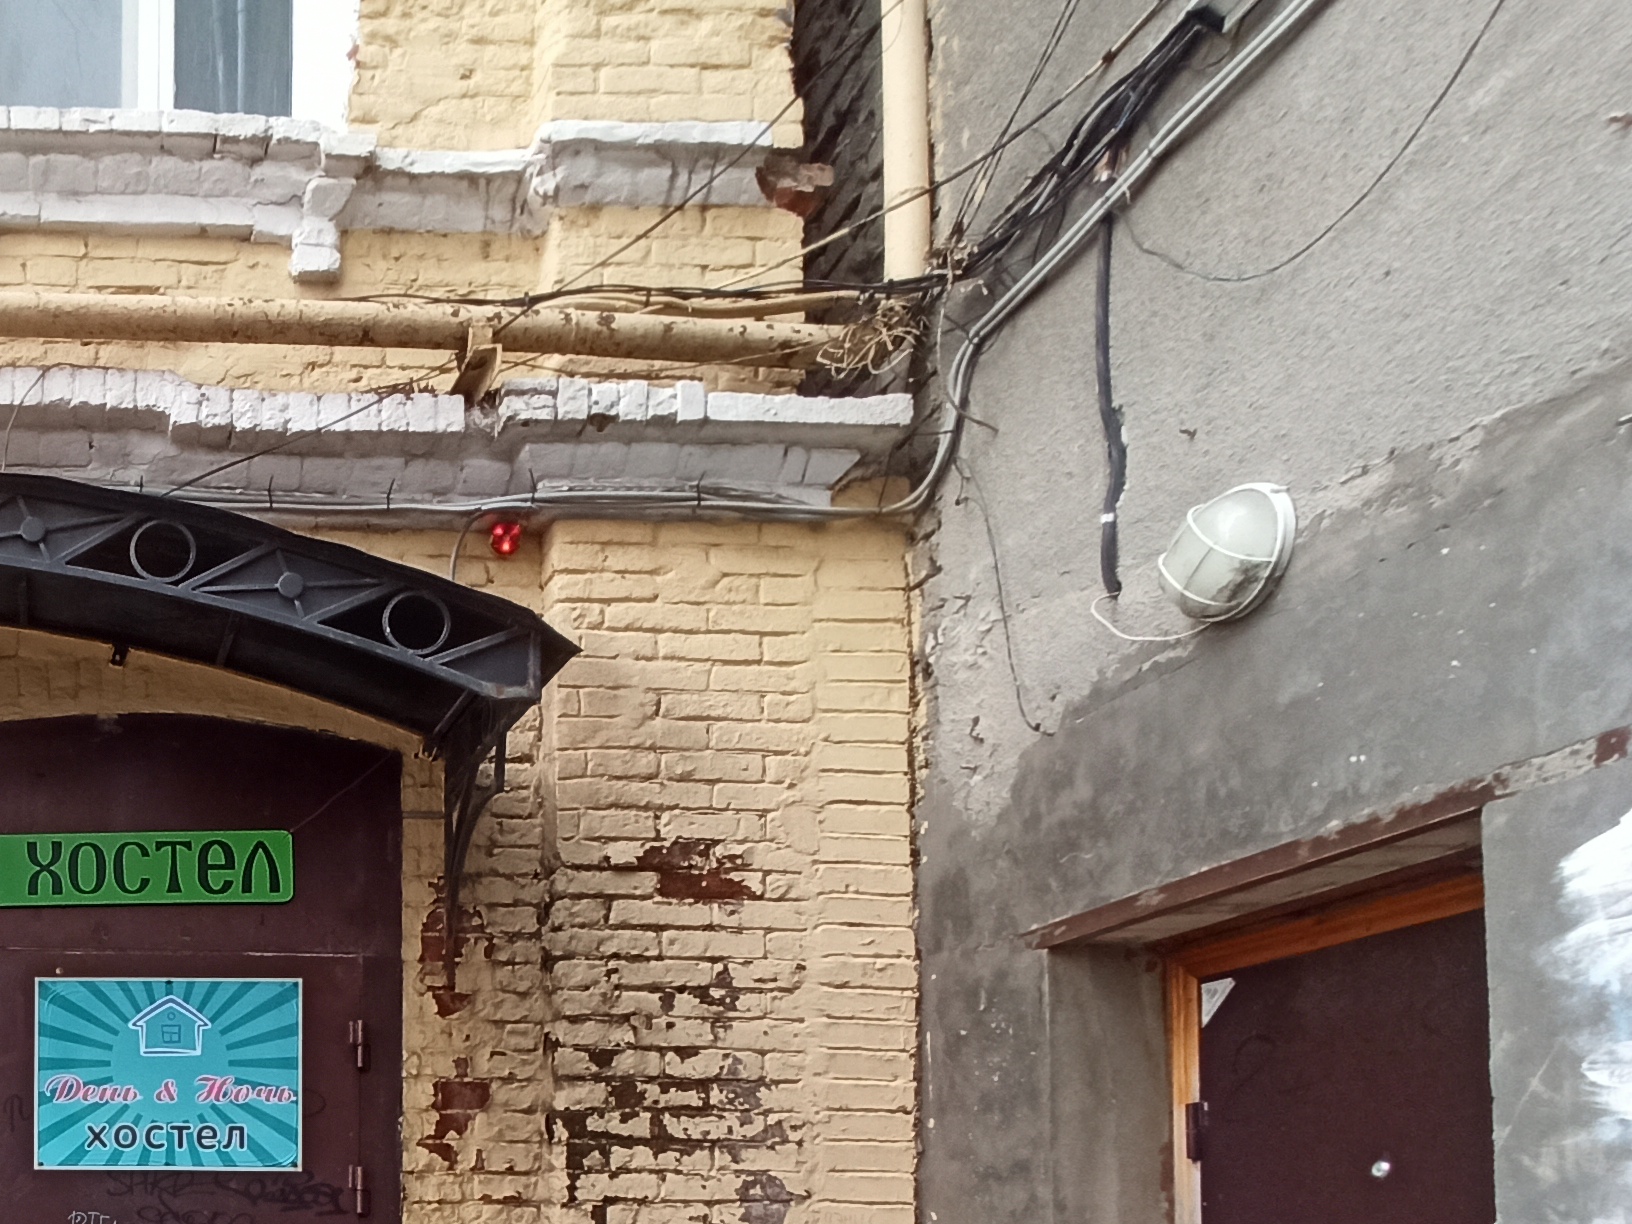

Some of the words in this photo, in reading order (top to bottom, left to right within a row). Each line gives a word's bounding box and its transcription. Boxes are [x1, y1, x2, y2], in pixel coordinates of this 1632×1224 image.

[43, 1073, 144, 1105] День
[154, 1078, 178, 1104] &
[193, 1074, 298, 1105] Ночь
[86, 1120, 247, 1151] хостел
